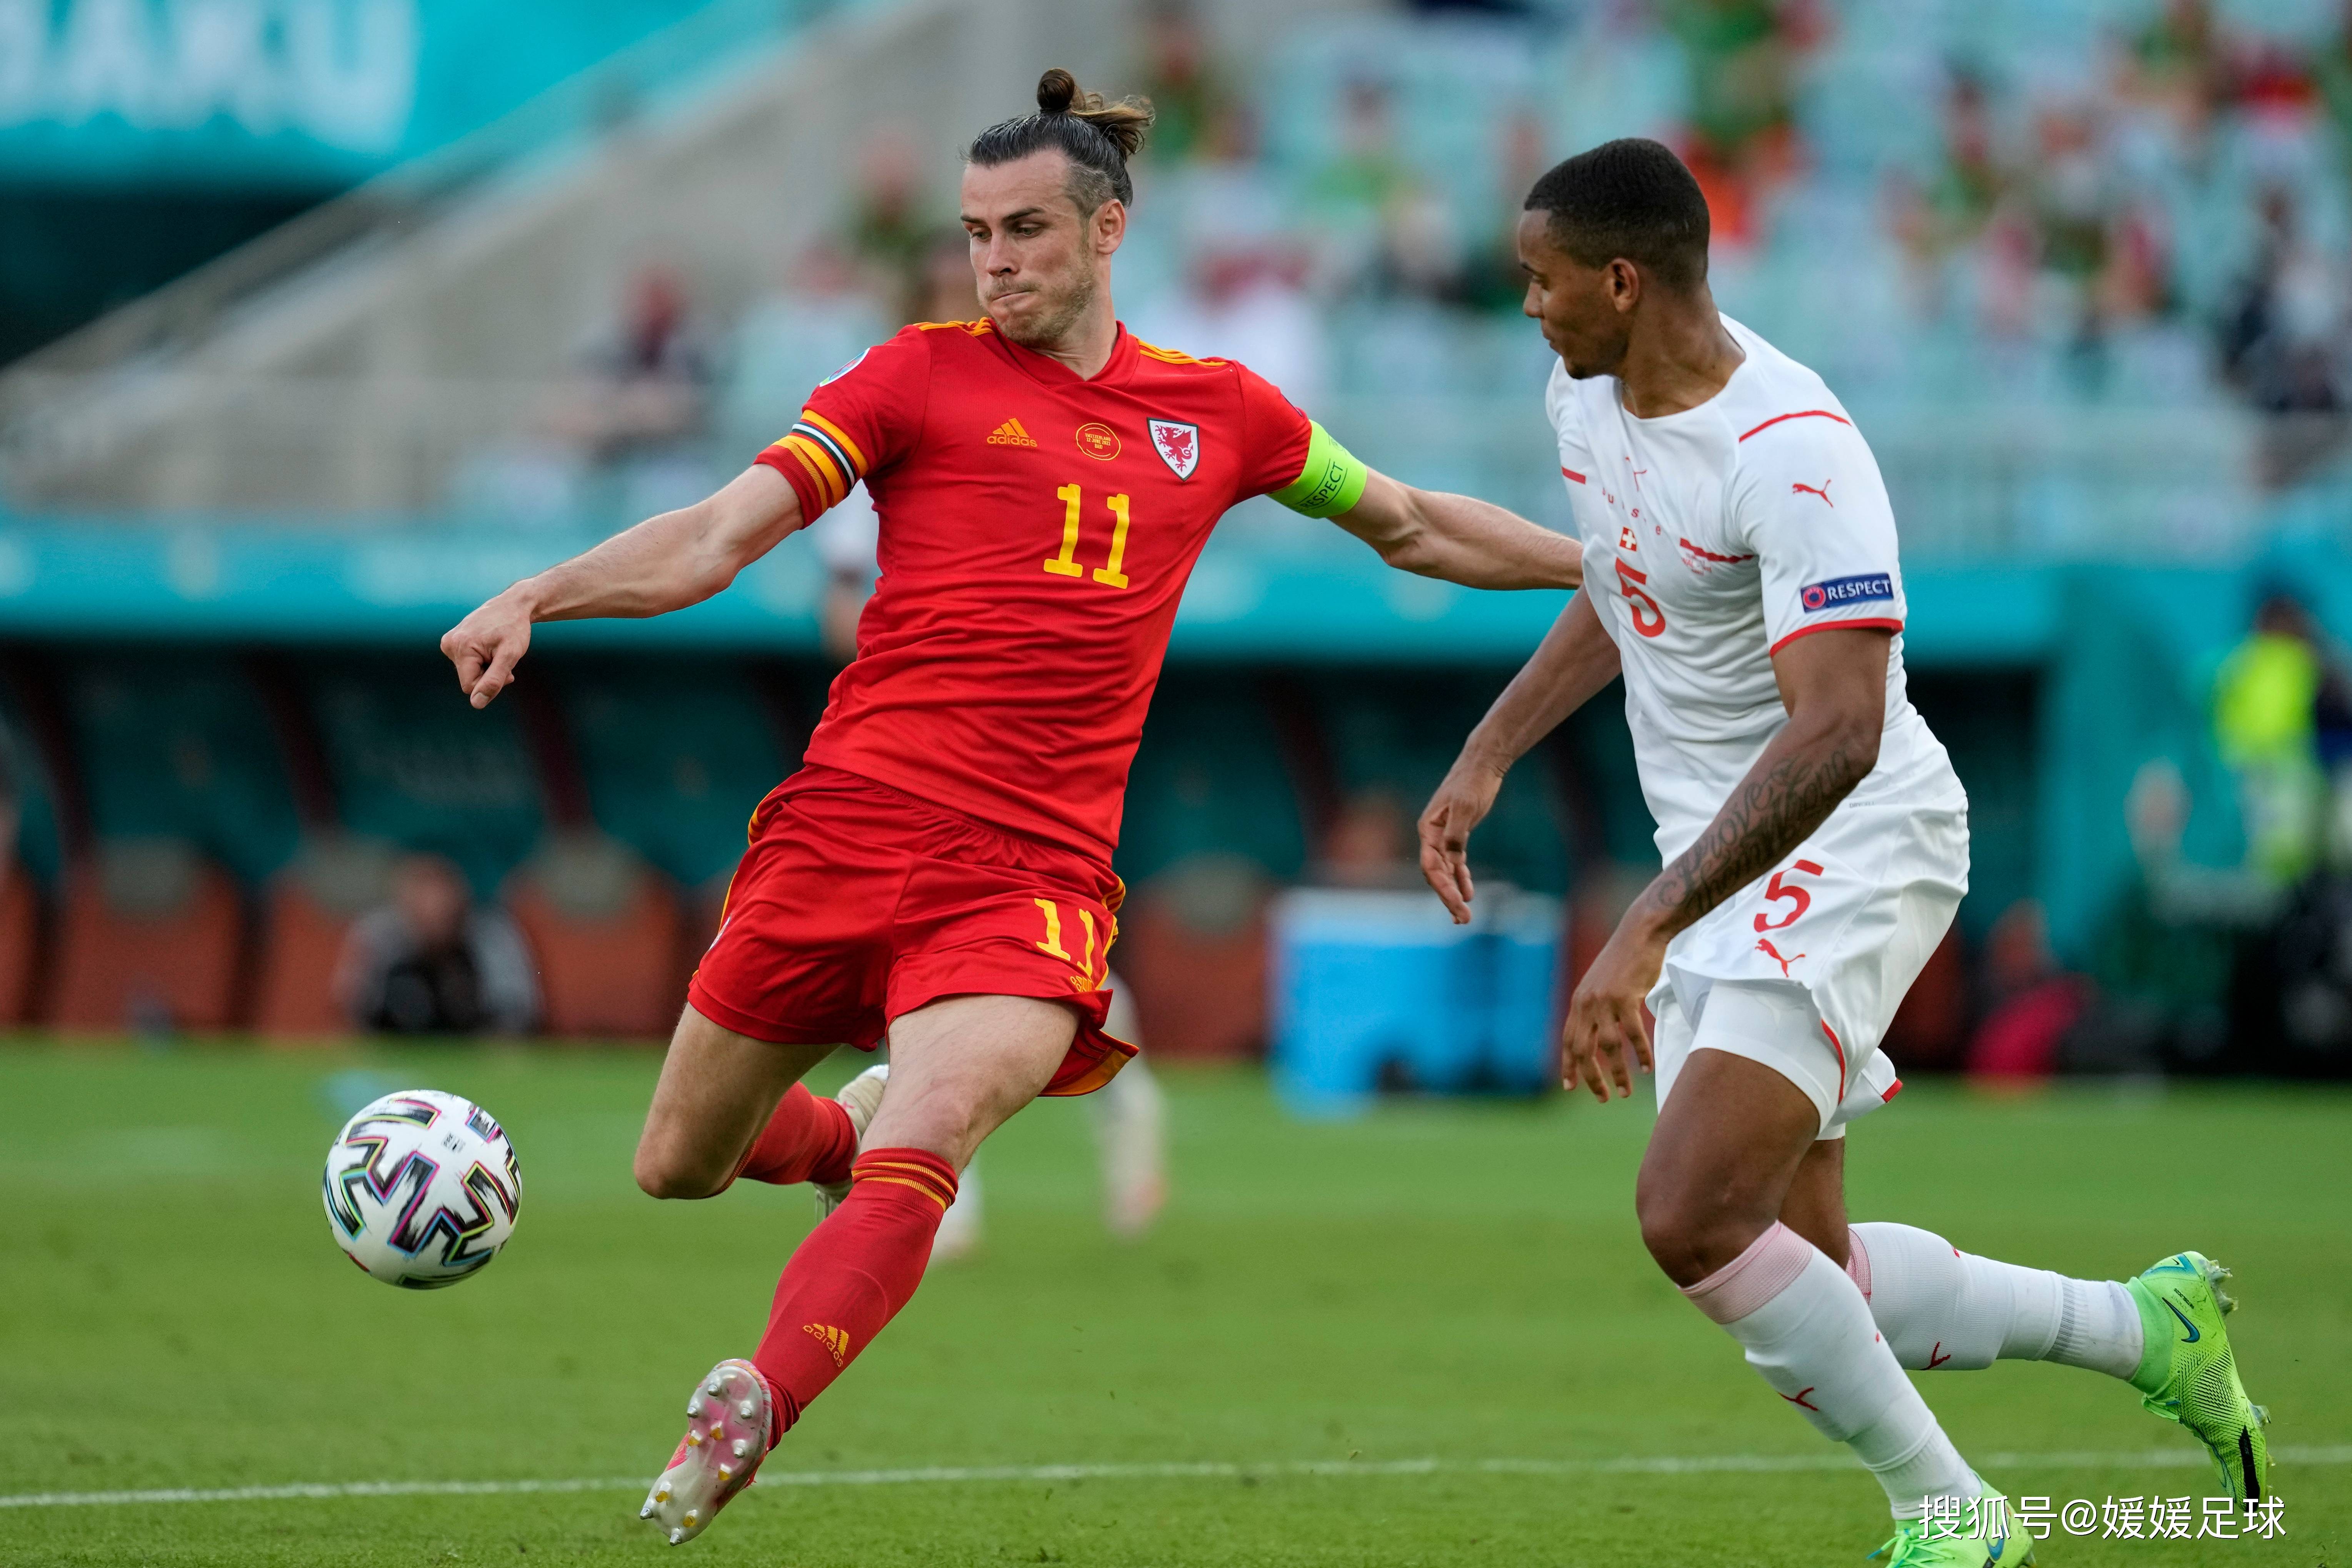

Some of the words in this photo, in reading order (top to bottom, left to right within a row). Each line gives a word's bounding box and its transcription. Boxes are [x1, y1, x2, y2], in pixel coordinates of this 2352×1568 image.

[987, 433, 1037, 447] adidas
[1085, 433, 1111, 442] SWITZERLAND
[1043, 483, 1130, 589] 11
[1615, 557, 1666, 638] 5
[1827, 579, 1890, 601] RESPECT
[1754, 859, 1824, 933] 5
[1034, 898, 1095, 980] 11
[802, 1325, 843, 1368] adidas
